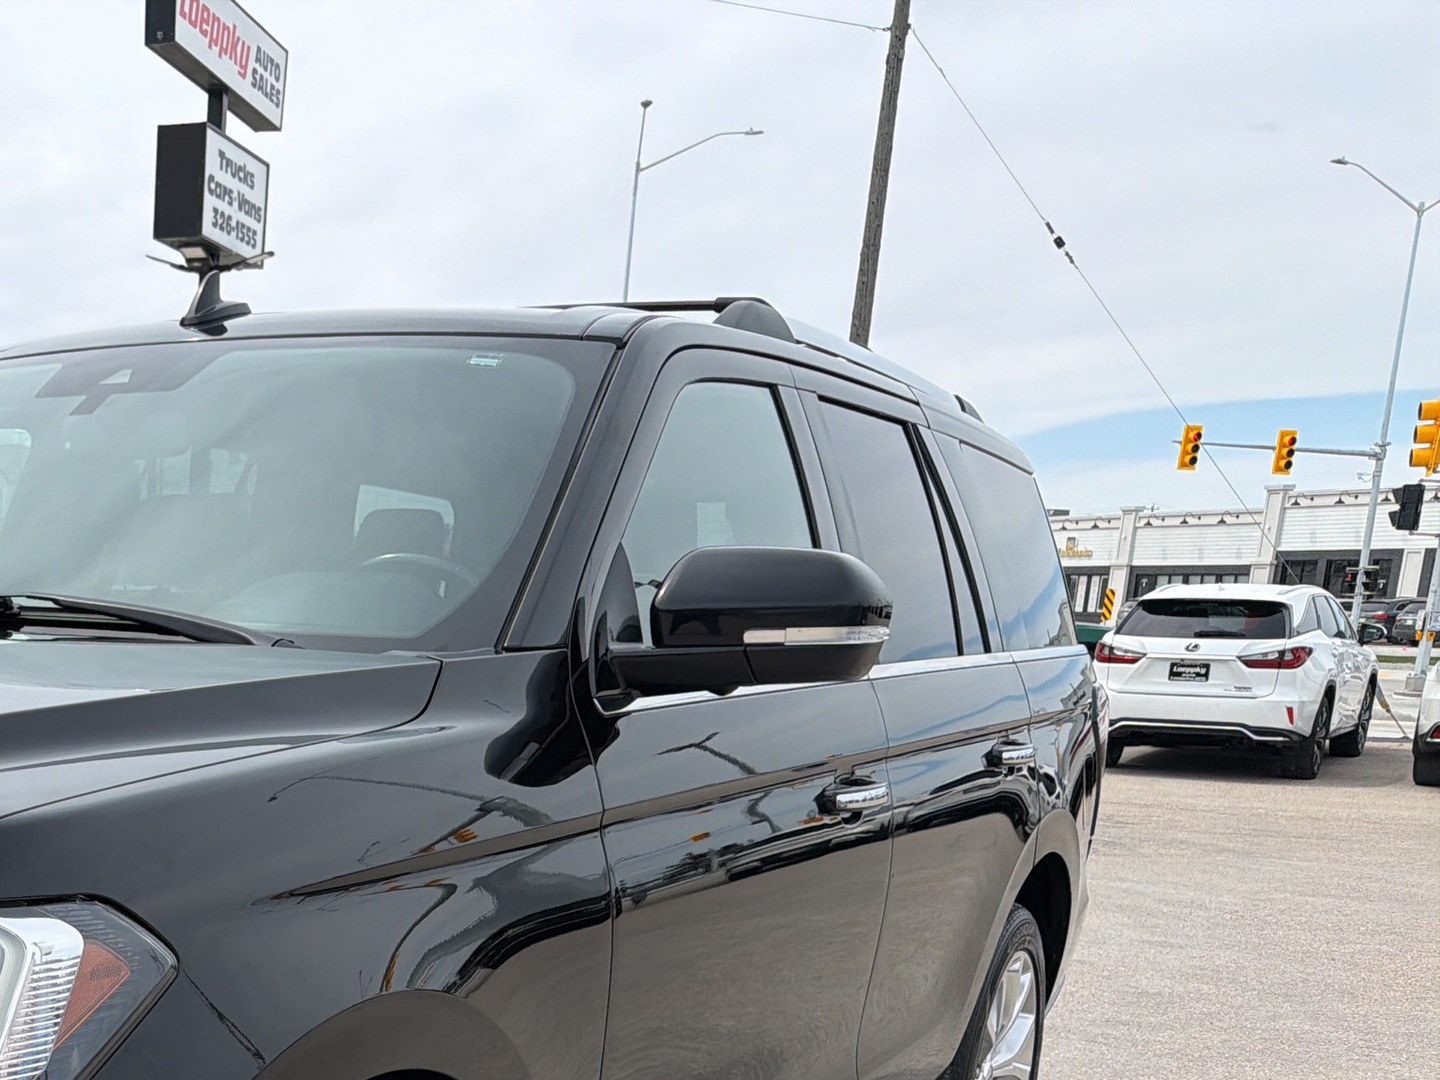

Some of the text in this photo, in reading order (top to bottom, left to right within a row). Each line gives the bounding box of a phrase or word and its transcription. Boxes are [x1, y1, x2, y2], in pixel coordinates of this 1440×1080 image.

[178, 0, 251, 81] Loeppky
[254, 44, 281, 84] AUTO
[250, 66, 281, 110] SALES
[218, 148, 256, 191] Trucks
[211, 205, 258, 250] 326-1555
